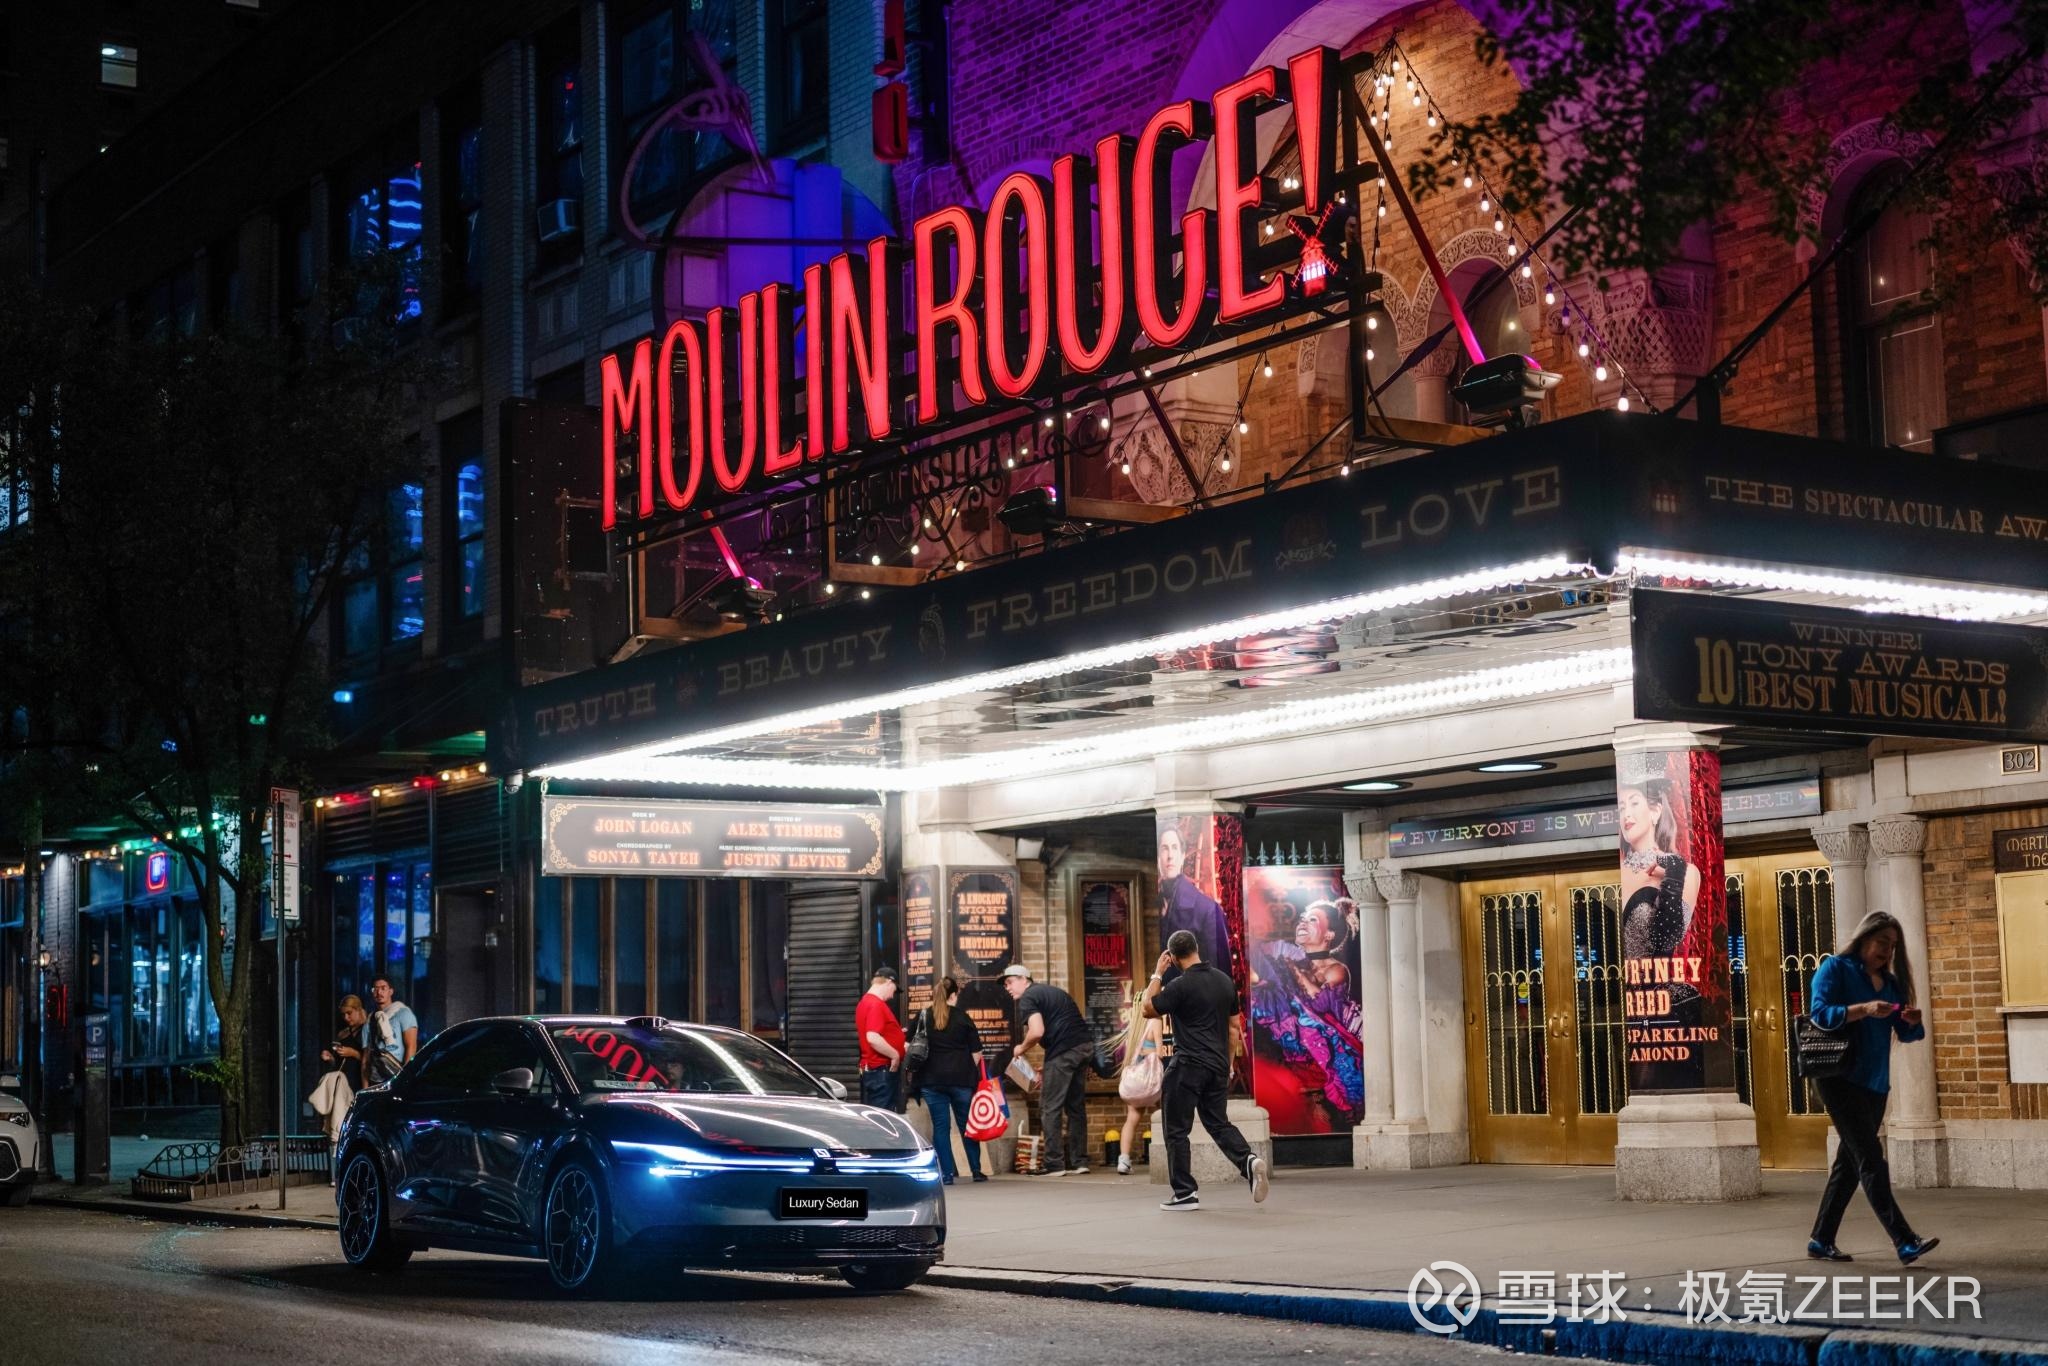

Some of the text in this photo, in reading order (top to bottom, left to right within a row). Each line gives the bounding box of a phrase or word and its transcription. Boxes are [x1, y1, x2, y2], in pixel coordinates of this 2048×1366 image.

[601, 237, 891, 531] MOULIN
[913, 46, 1335, 423] ROUGE!
[1359, 466, 1562, 548] LOVE
[1705, 476, 2048, 541] THE SPECTACULAR AW
[967, 538, 1253, 640] FREEDOM
[1790, 621, 1923, 650] WINNER!
[717, 626, 892, 696] BEAUTY
[1694, 637, 1736, 705] 10
[1737, 640, 1842, 672] TONY
[1744, 670, 1836, 712] BEST
[1849, 679, 2007, 724] MUSICAL!
[535, 683, 657, 737] TRUTH
[2004, 750, 2036, 771] 302
[594, 818, 693, 834] JOHN LOGAN
[727, 823, 843, 839] ALEX TIMBERS
[1409, 819, 1535, 846] EVERYONE
[1544, 816, 1568, 831] IS
[587, 850, 640, 864] SONYA
[724, 853, 848, 868] JUSTIN LEVINE
[959, 906, 1007, 915] NIGHT
[967, 893, 1007, 905] KNOCKOUT
[959, 936, 1008, 949] EMOTIONAL
[92, 1026, 103, 1042] P
[789, 1196, 859, 1210] Luxury Sedan
